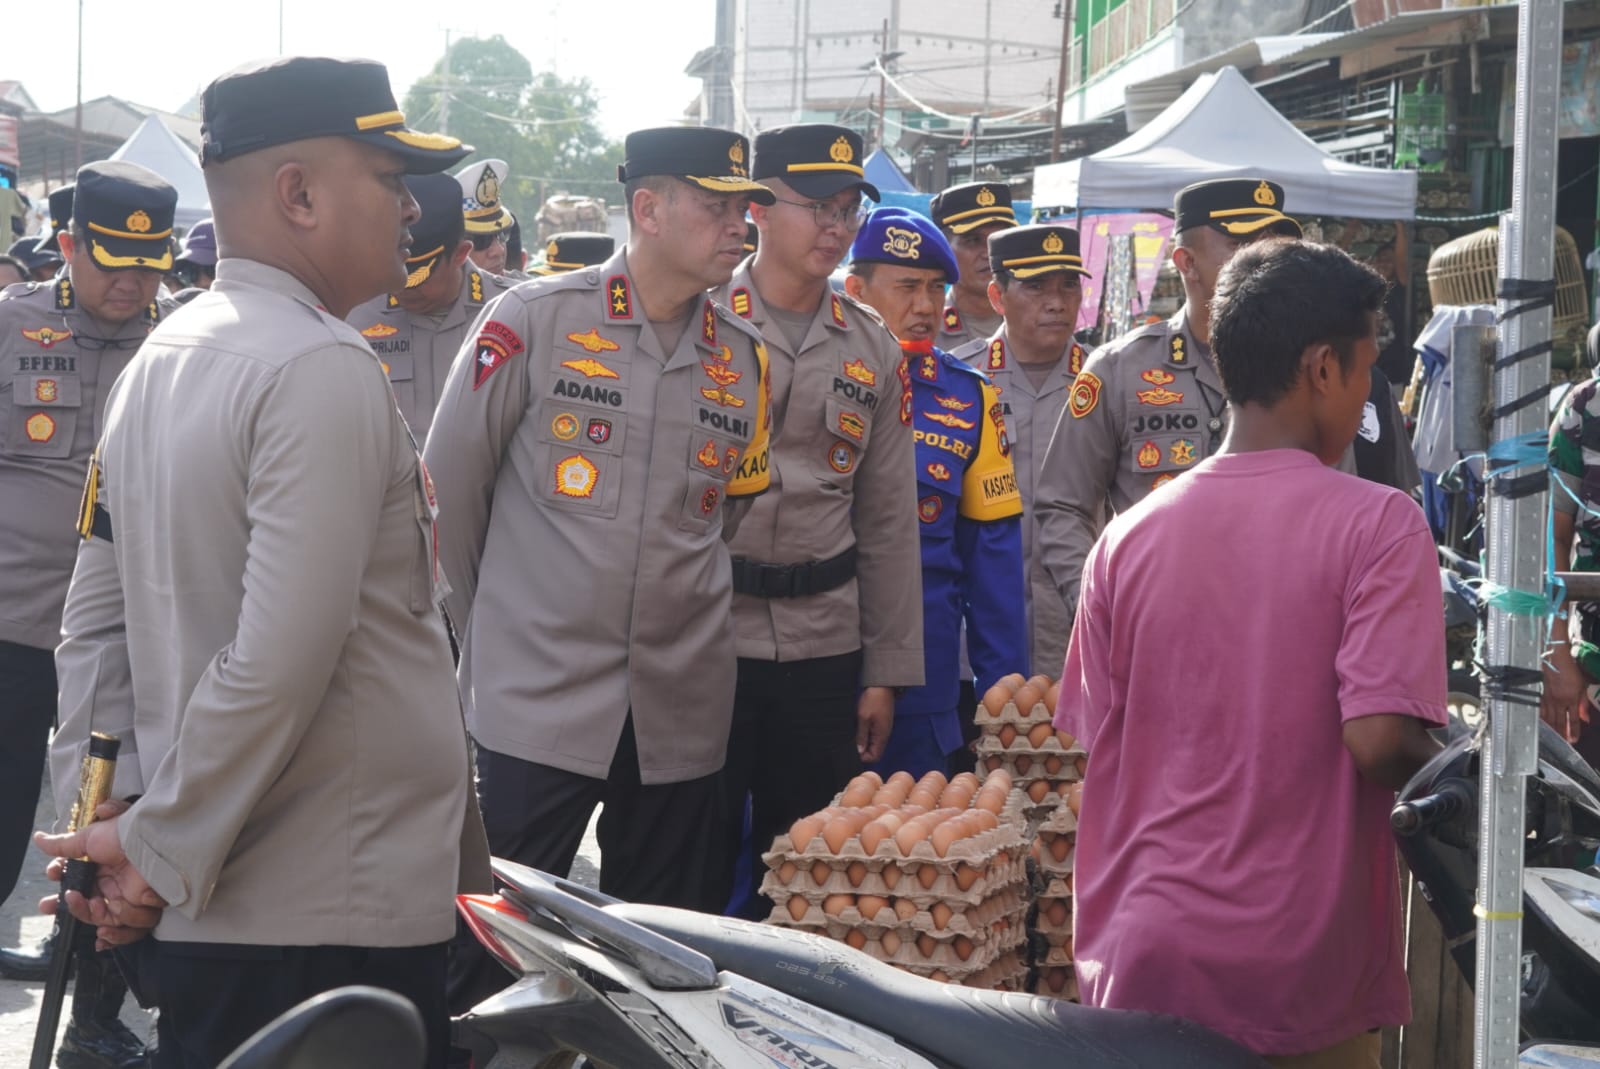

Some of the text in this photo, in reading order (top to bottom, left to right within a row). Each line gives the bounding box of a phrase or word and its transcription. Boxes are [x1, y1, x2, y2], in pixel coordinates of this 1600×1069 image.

[19, 356, 76, 371] EFFRI
[553, 378, 622, 407] ADANG
[833, 377, 878, 410] POLRI
[699, 407, 748, 438] POLRI
[1134, 414, 1198, 432] JOKO
[913, 429, 973, 460] POLRI
[736, 448, 769, 479] KAO
[982, 473, 1018, 499] KASATGA
